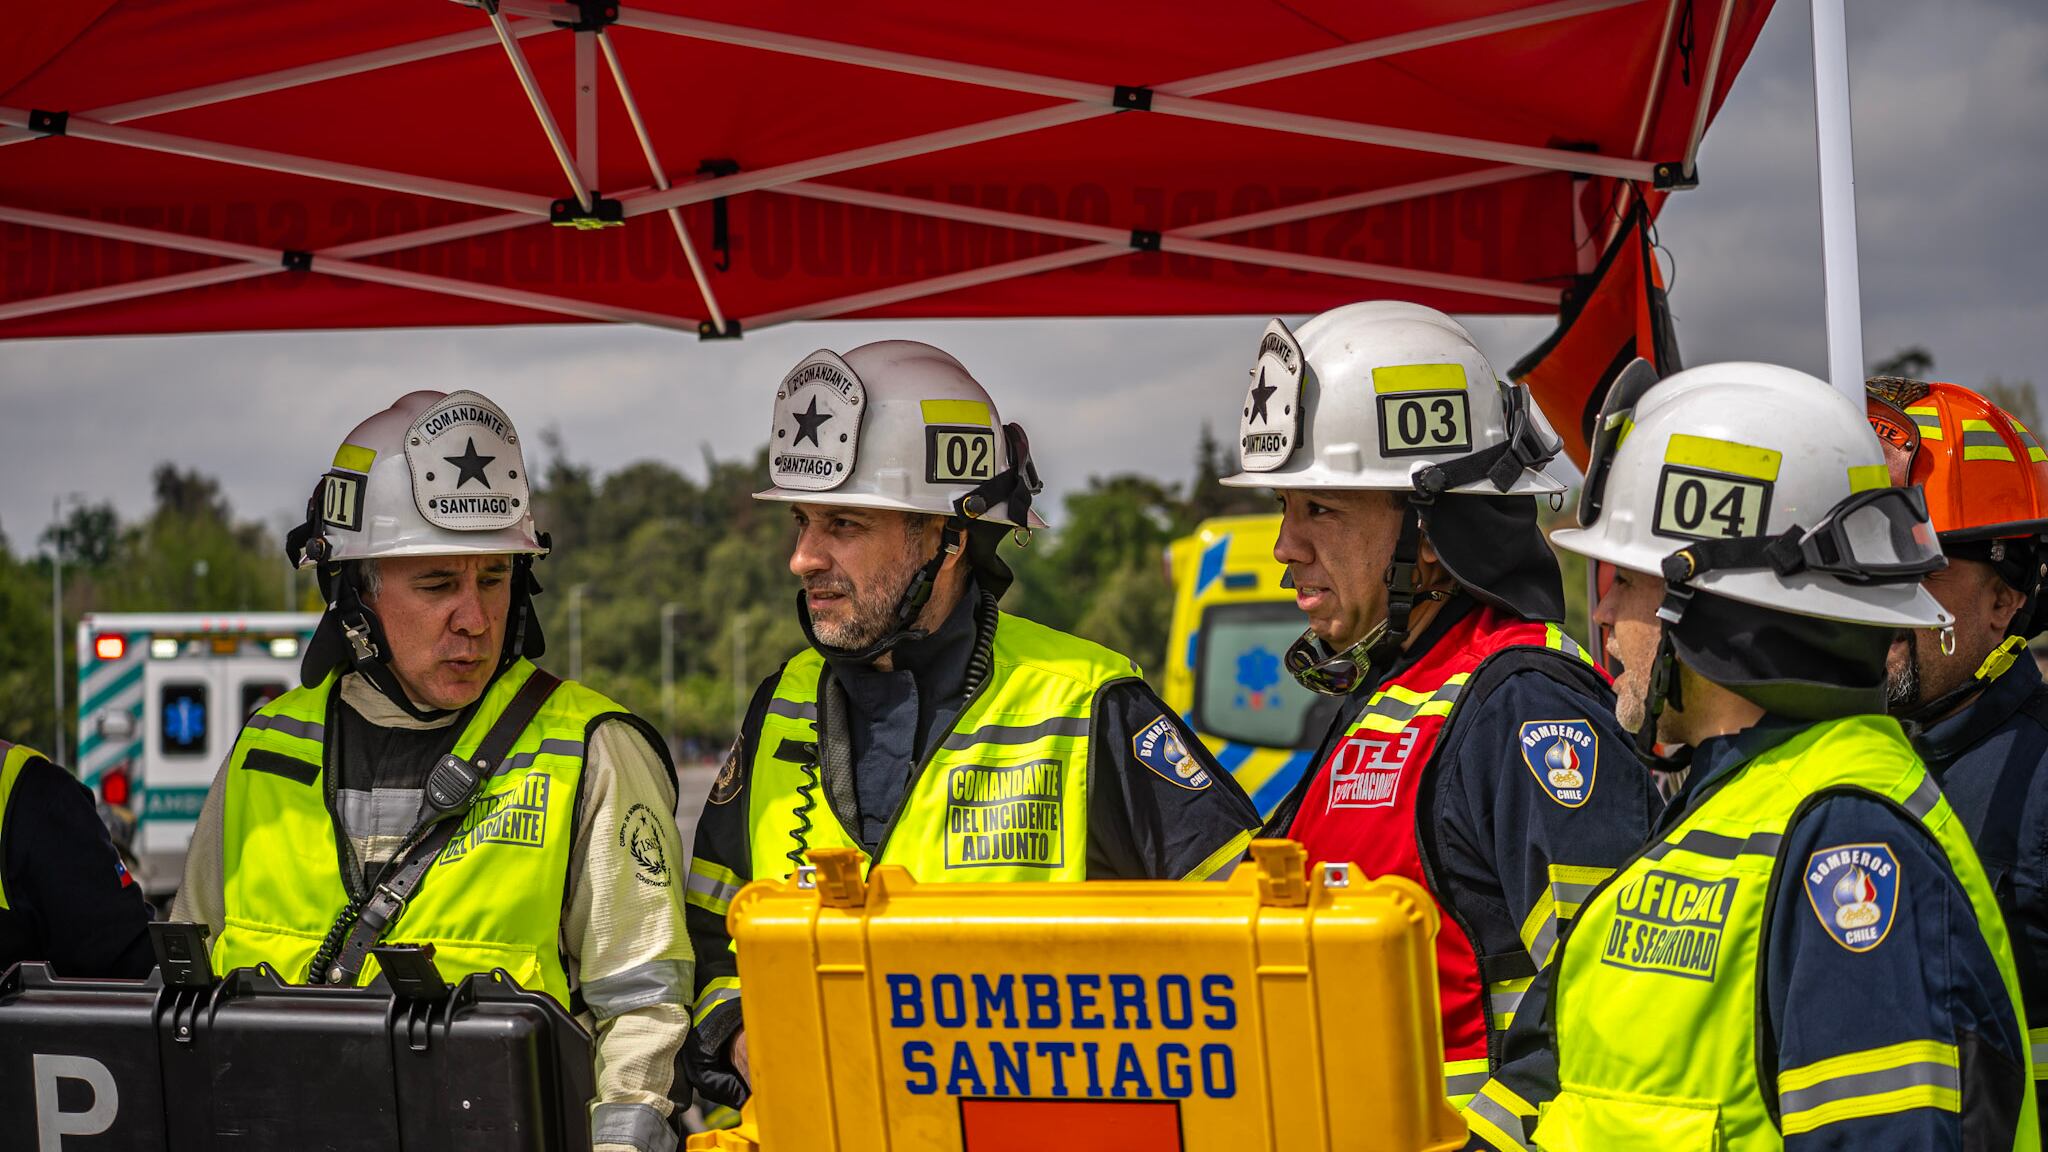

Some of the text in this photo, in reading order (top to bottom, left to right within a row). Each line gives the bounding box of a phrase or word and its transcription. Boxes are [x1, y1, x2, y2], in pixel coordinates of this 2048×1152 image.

[425, 406, 504, 436] COMANDANTE
[1397, 399, 1457, 446] 03
[782, 457, 832, 476] SANTIAGO
[946, 435, 988, 478] 02
[326, 479, 347, 522] 01
[440, 498, 507, 514] SANTIAGO
[1674, 478, 1746, 538] 04
[1140, 720, 1169, 757] BOMBE
[1525, 724, 1591, 748] BOMBEROS
[952, 764, 1058, 801] COMANDANTE
[1556, 789, 1583, 801] CHILE
[951, 802, 1058, 833] DEL INCIDENTE
[962, 832, 1048, 861] ADJUNTO
[1809, 849, 1891, 885] BOMBEROS
[1619, 874, 1728, 923] OFICIAL
[1606, 918, 1717, 971] DE SEGURIDAD
[1845, 926, 1877, 944] CHILE
[886, 973, 1238, 1030] BOMBEROS
[903, 1040, 1237, 1098] SANTIAGO
[33, 1053, 119, 1152] P
